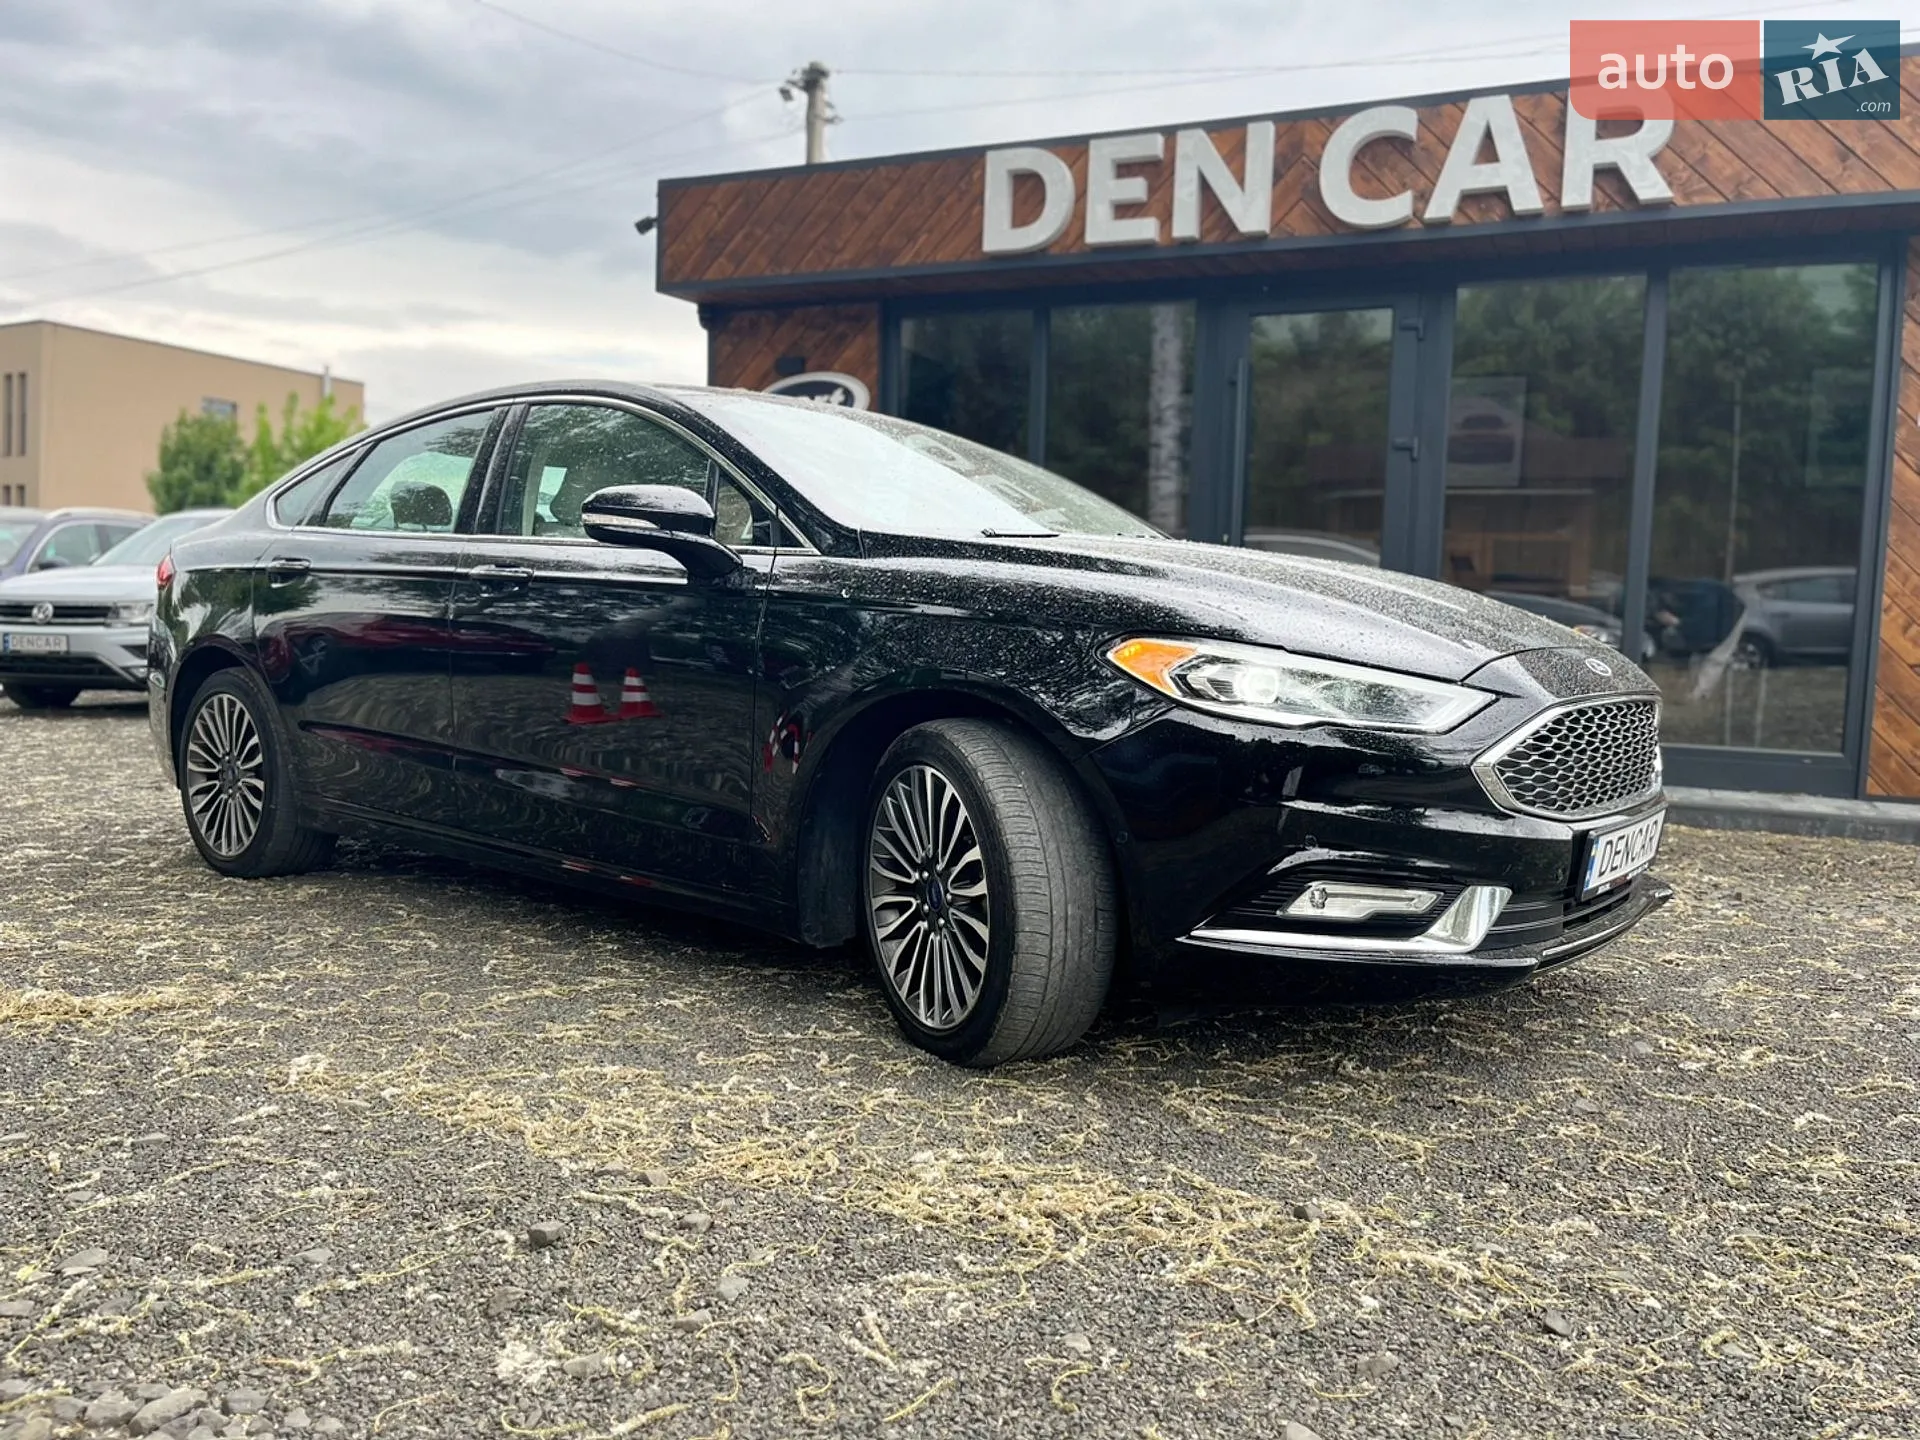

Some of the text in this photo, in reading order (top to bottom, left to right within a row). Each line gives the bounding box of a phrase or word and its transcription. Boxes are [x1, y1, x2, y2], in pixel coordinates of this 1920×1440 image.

[981, 86, 1676, 257] DEN CAR
[11, 634, 62, 650] DENCAR
[1598, 819, 1659, 878] DENCAR
